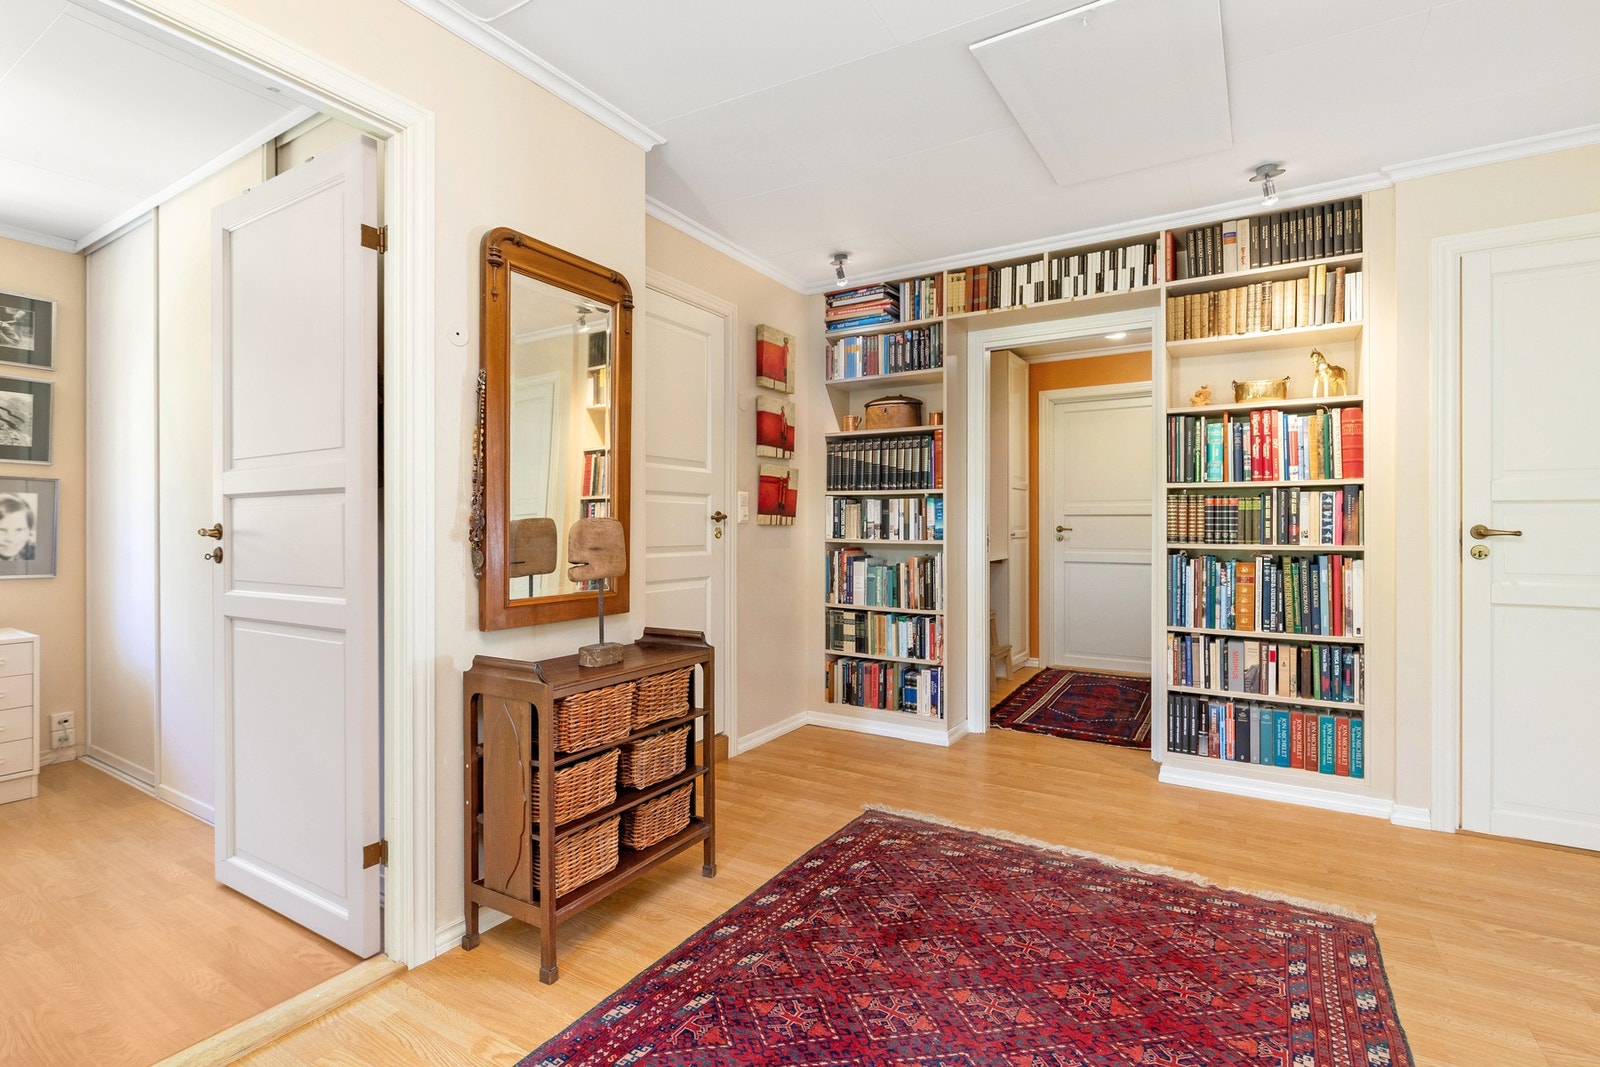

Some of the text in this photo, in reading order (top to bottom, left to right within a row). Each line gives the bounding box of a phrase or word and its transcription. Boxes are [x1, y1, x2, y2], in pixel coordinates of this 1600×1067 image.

[1284, 575, 1292, 606] NORTHERN
[1232, 650, 1240, 681] MINIHUS
[1309, 721, 1317, 733] JON
